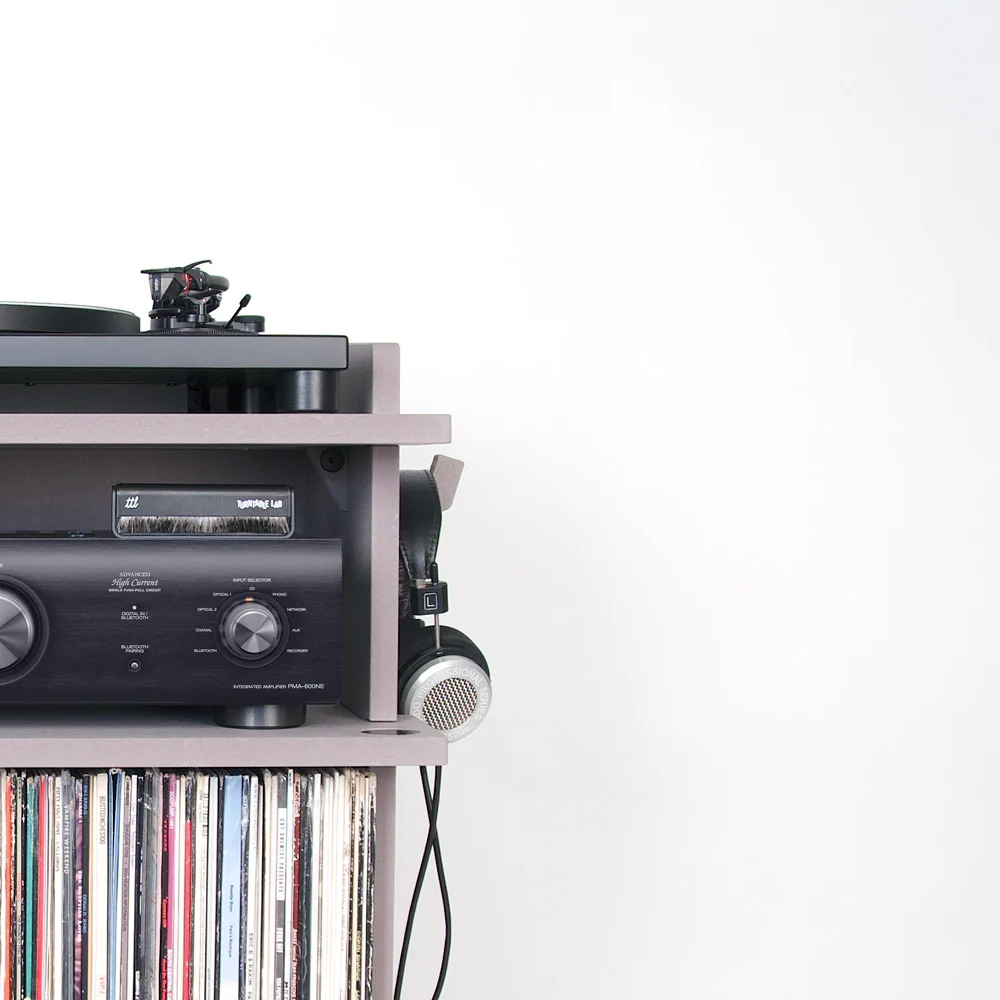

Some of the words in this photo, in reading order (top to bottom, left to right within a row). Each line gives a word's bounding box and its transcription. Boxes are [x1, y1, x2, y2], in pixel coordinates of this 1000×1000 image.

[125, 496, 139, 509] ttl
[237, 499, 269, 510] TURNTABLE
[271, 499, 283, 509] LAB
[111, 578, 130, 588] High
[131, 578, 159, 587] Current
[426, 596, 435, 607] L
